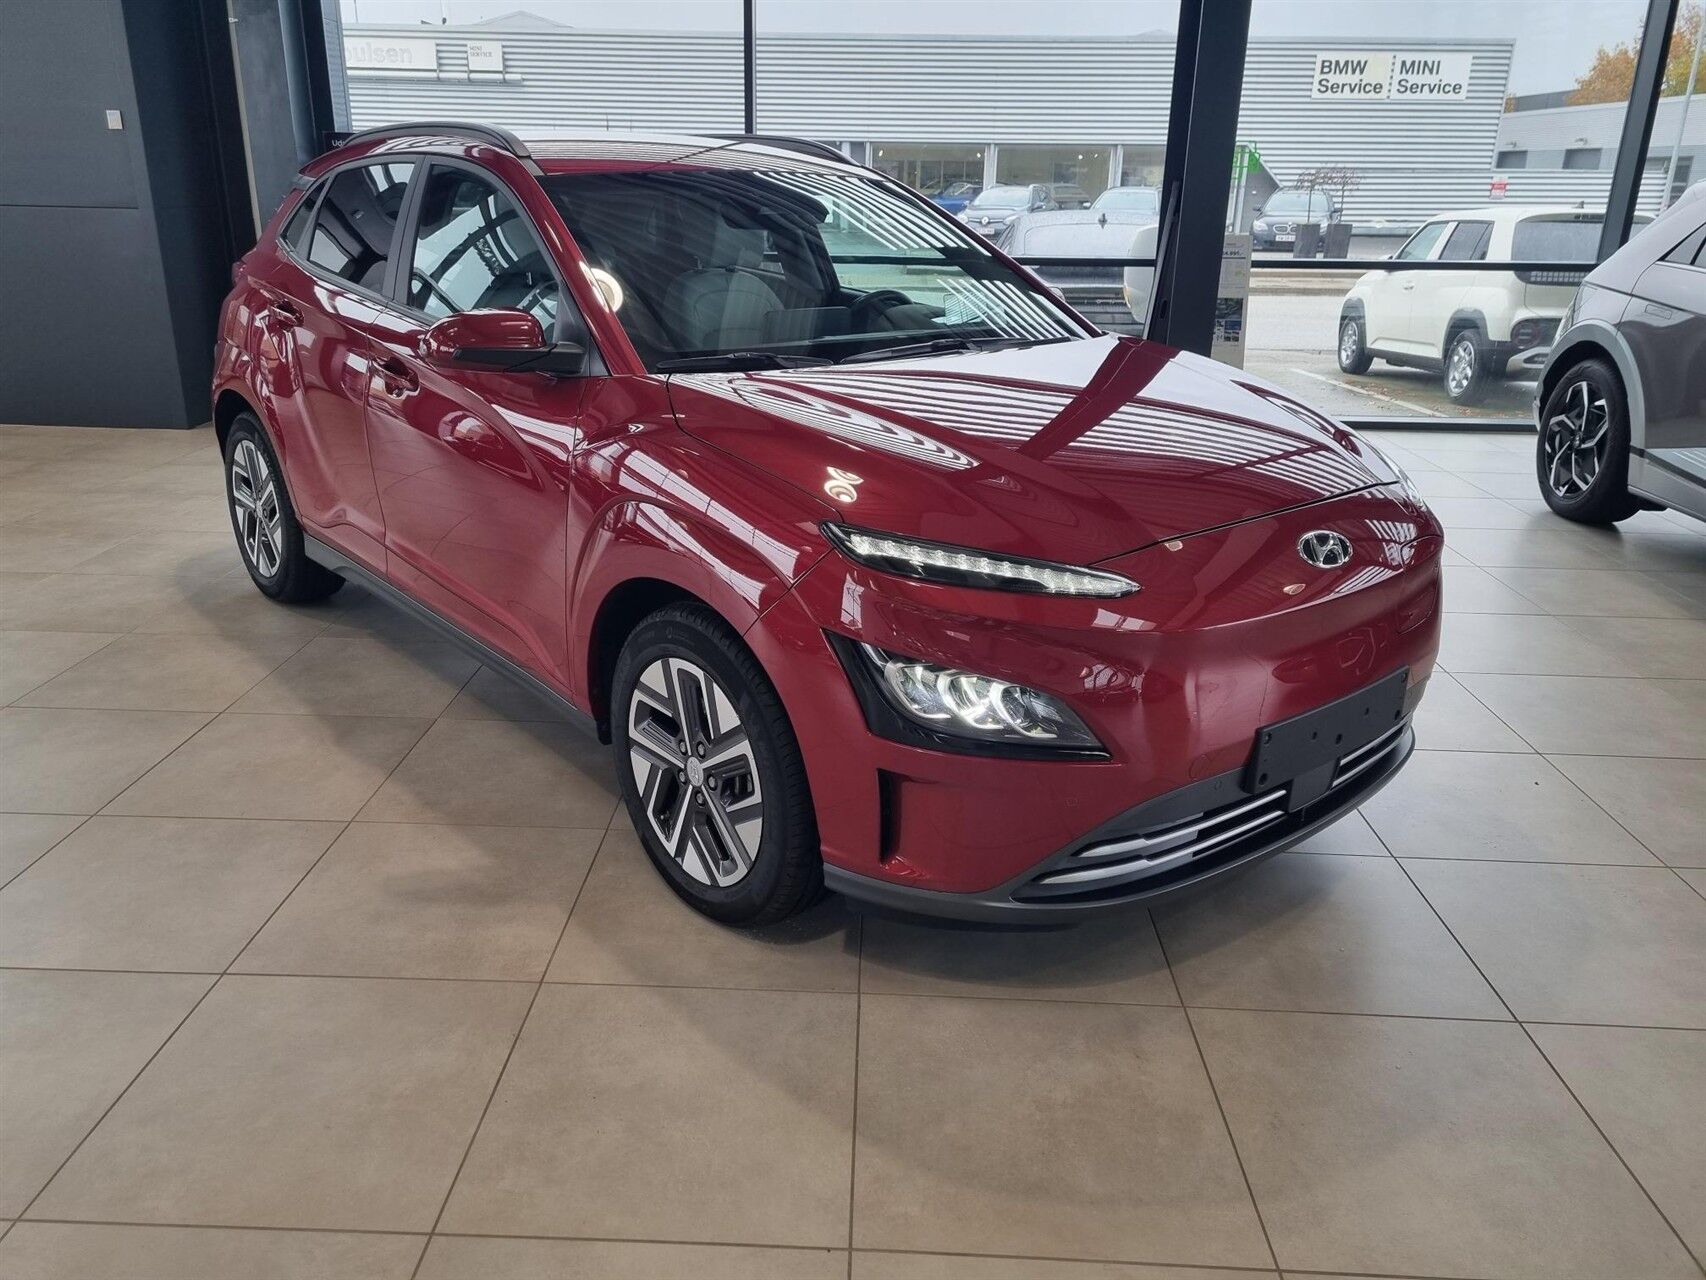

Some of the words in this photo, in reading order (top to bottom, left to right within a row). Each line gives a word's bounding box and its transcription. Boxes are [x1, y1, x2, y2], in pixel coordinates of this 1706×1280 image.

[1319, 60, 1368, 75] BMW
[1399, 60, 1441, 75] MINI
[1317, 78, 1384, 94] Service
[1396, 79, 1463, 94] Service
